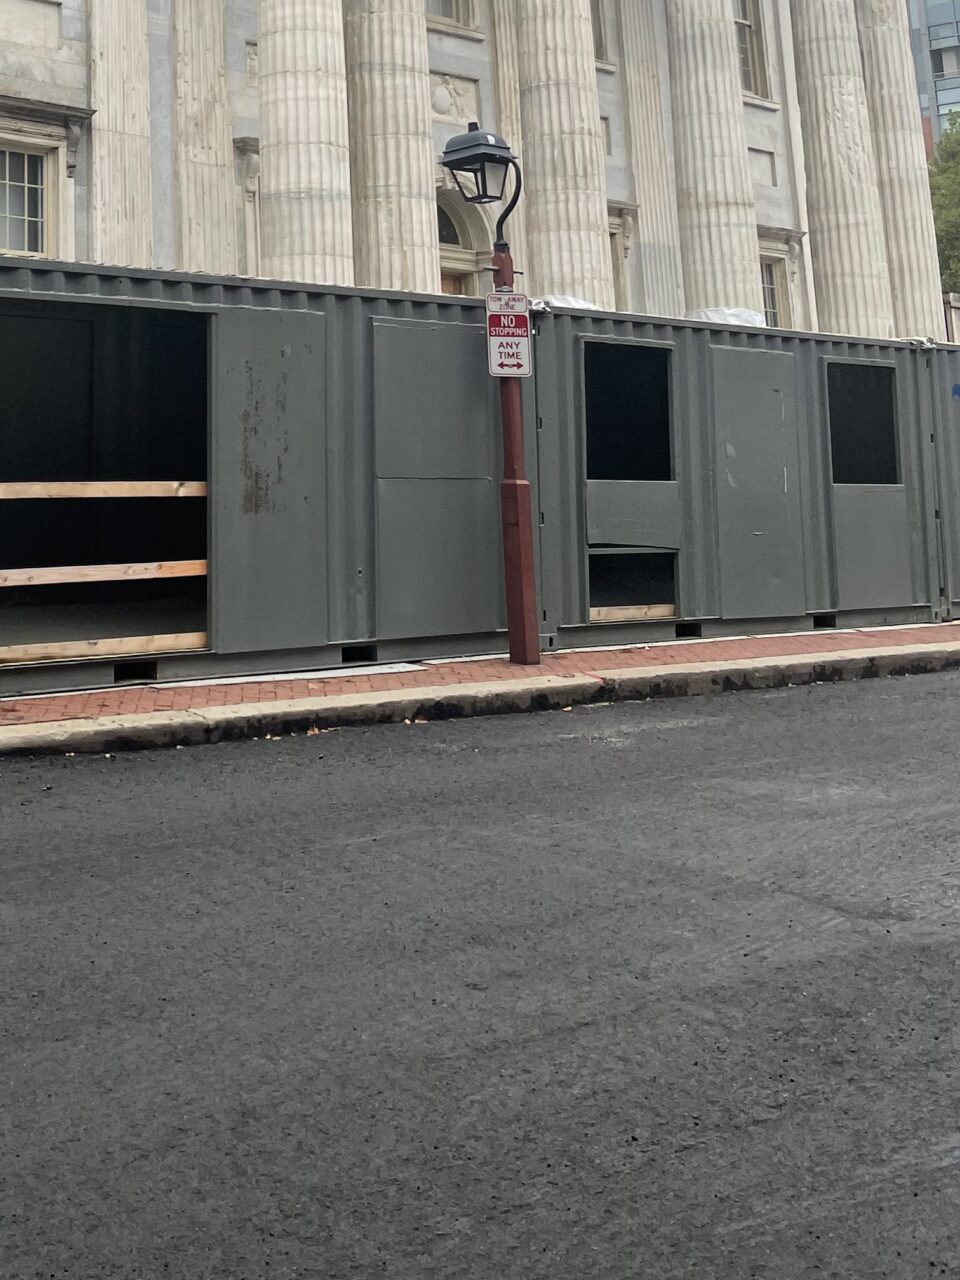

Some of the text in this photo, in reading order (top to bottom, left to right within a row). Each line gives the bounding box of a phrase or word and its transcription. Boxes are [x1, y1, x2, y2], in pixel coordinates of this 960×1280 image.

[500, 315, 516, 327] NO
[490, 327, 528, 337] STOPPING
[497, 341, 521, 350] ANY
[498, 351, 522, 360] TIME
